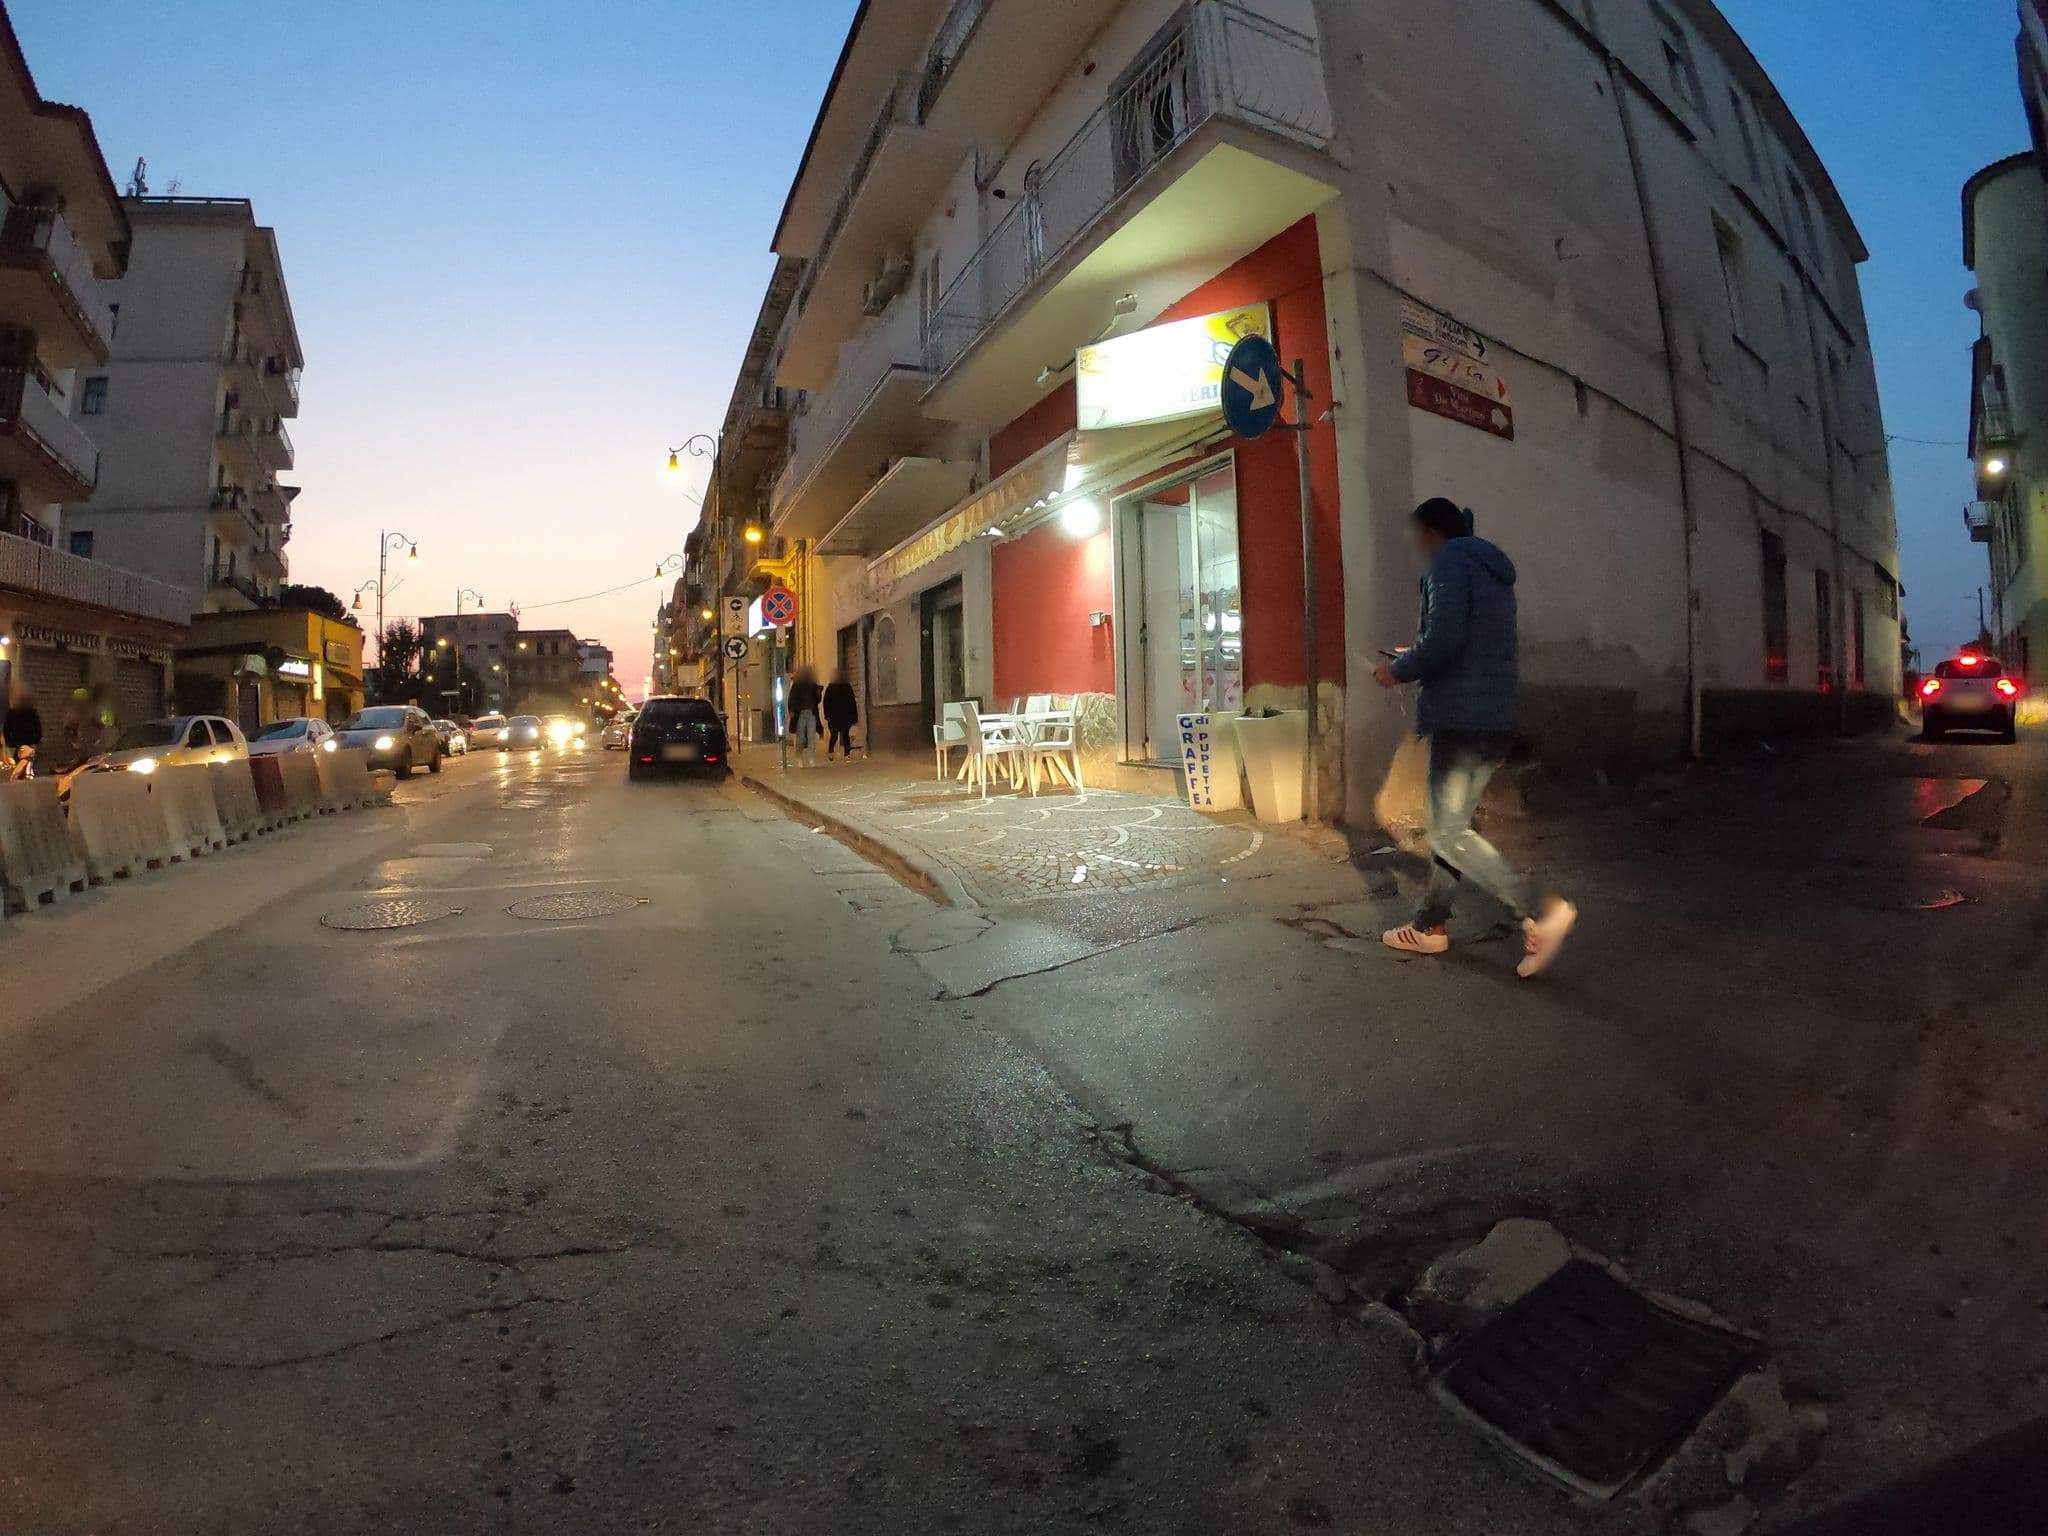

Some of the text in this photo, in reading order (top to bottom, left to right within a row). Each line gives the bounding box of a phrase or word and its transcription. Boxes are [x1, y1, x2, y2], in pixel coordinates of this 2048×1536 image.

[1179, 717, 1201, 805] GRAFFE
[1195, 716, 1212, 806] di PUPETTA
